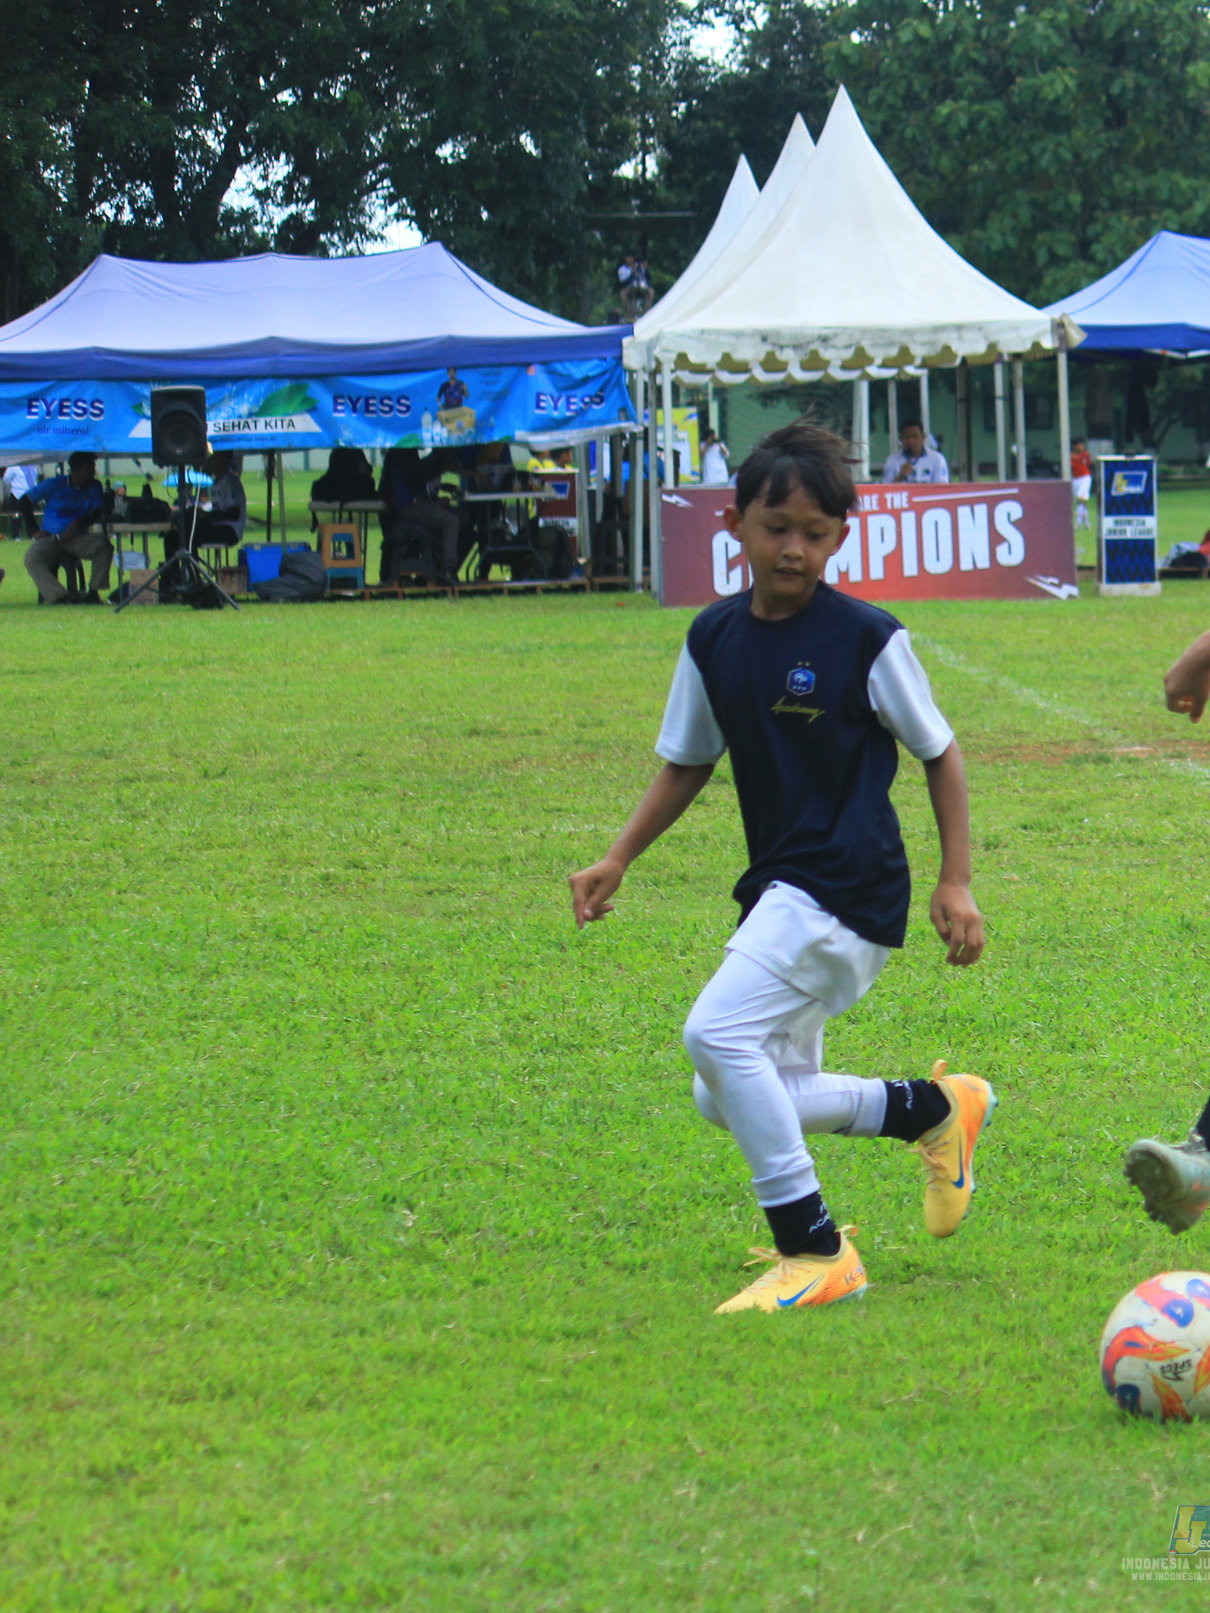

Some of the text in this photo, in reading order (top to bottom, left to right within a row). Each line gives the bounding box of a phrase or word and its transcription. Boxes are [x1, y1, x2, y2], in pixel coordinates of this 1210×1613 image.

[25, 398, 104, 421] EYESS
[332, 394, 411, 417] EYESS
[213, 418, 296, 433] SEHAT KITA
[885, 491, 909, 509] THE
[712, 500, 1025, 597] CMPIONS
